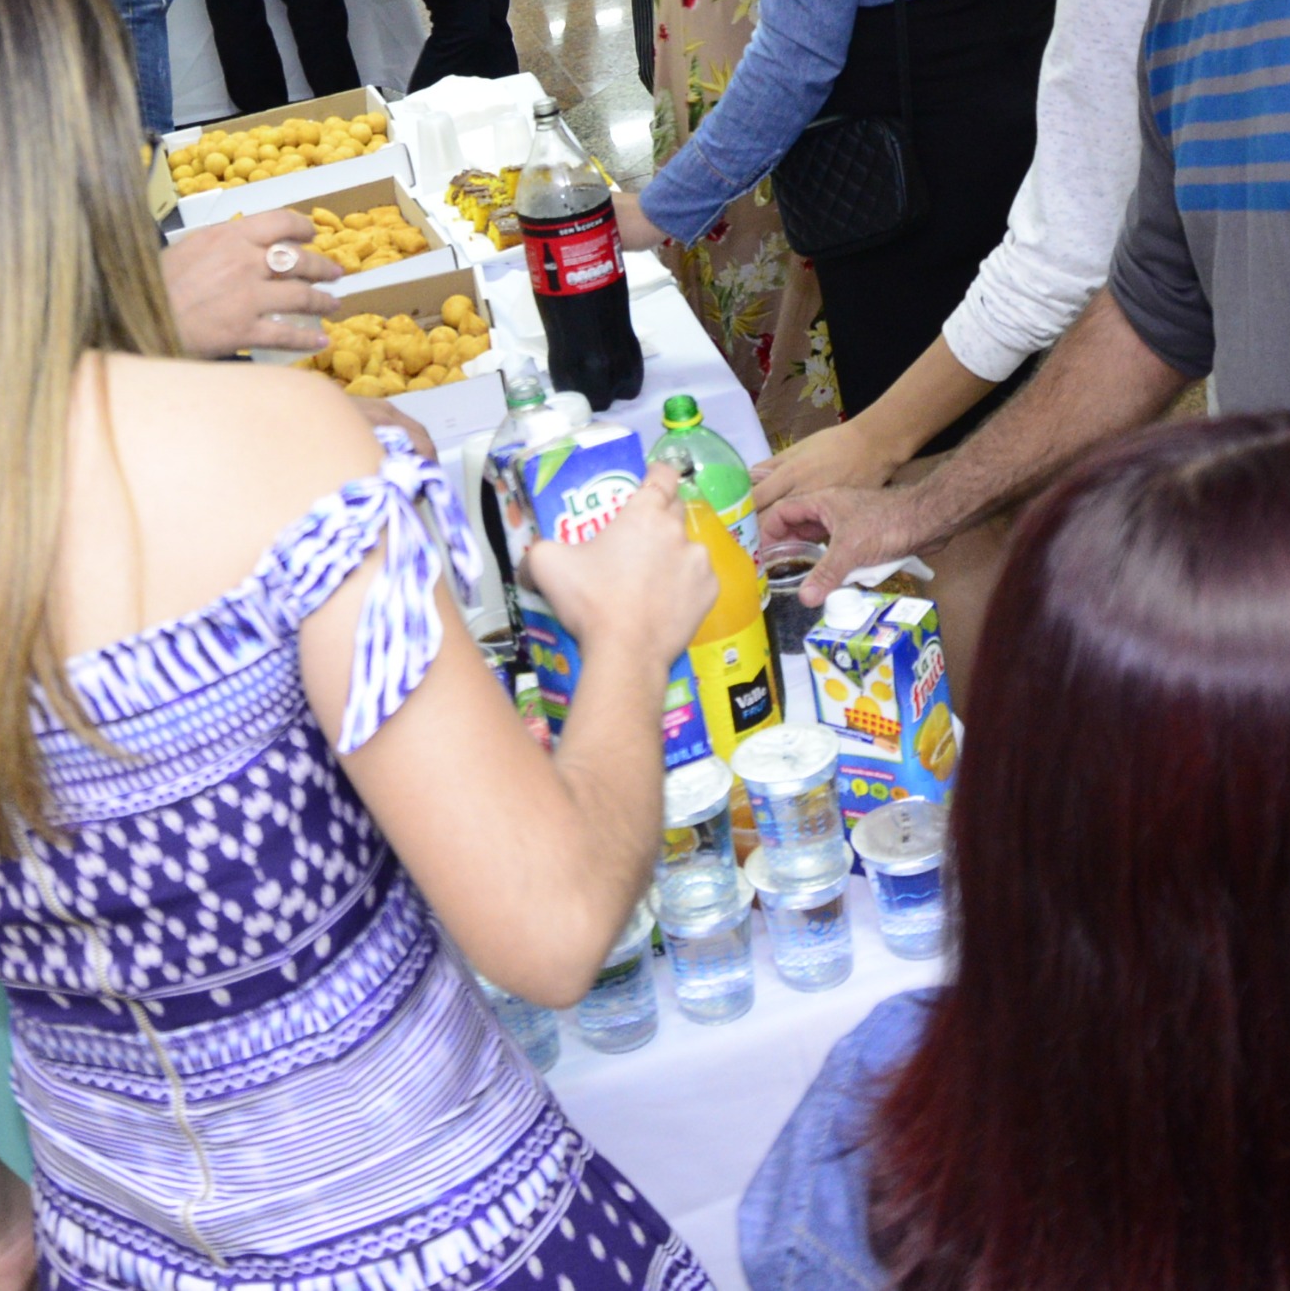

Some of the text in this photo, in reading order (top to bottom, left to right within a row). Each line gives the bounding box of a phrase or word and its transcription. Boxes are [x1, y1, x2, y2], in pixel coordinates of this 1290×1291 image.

[568, 492, 602, 517] La
[735, 686, 767, 709] Valle
[913, 652, 945, 720] fruit
